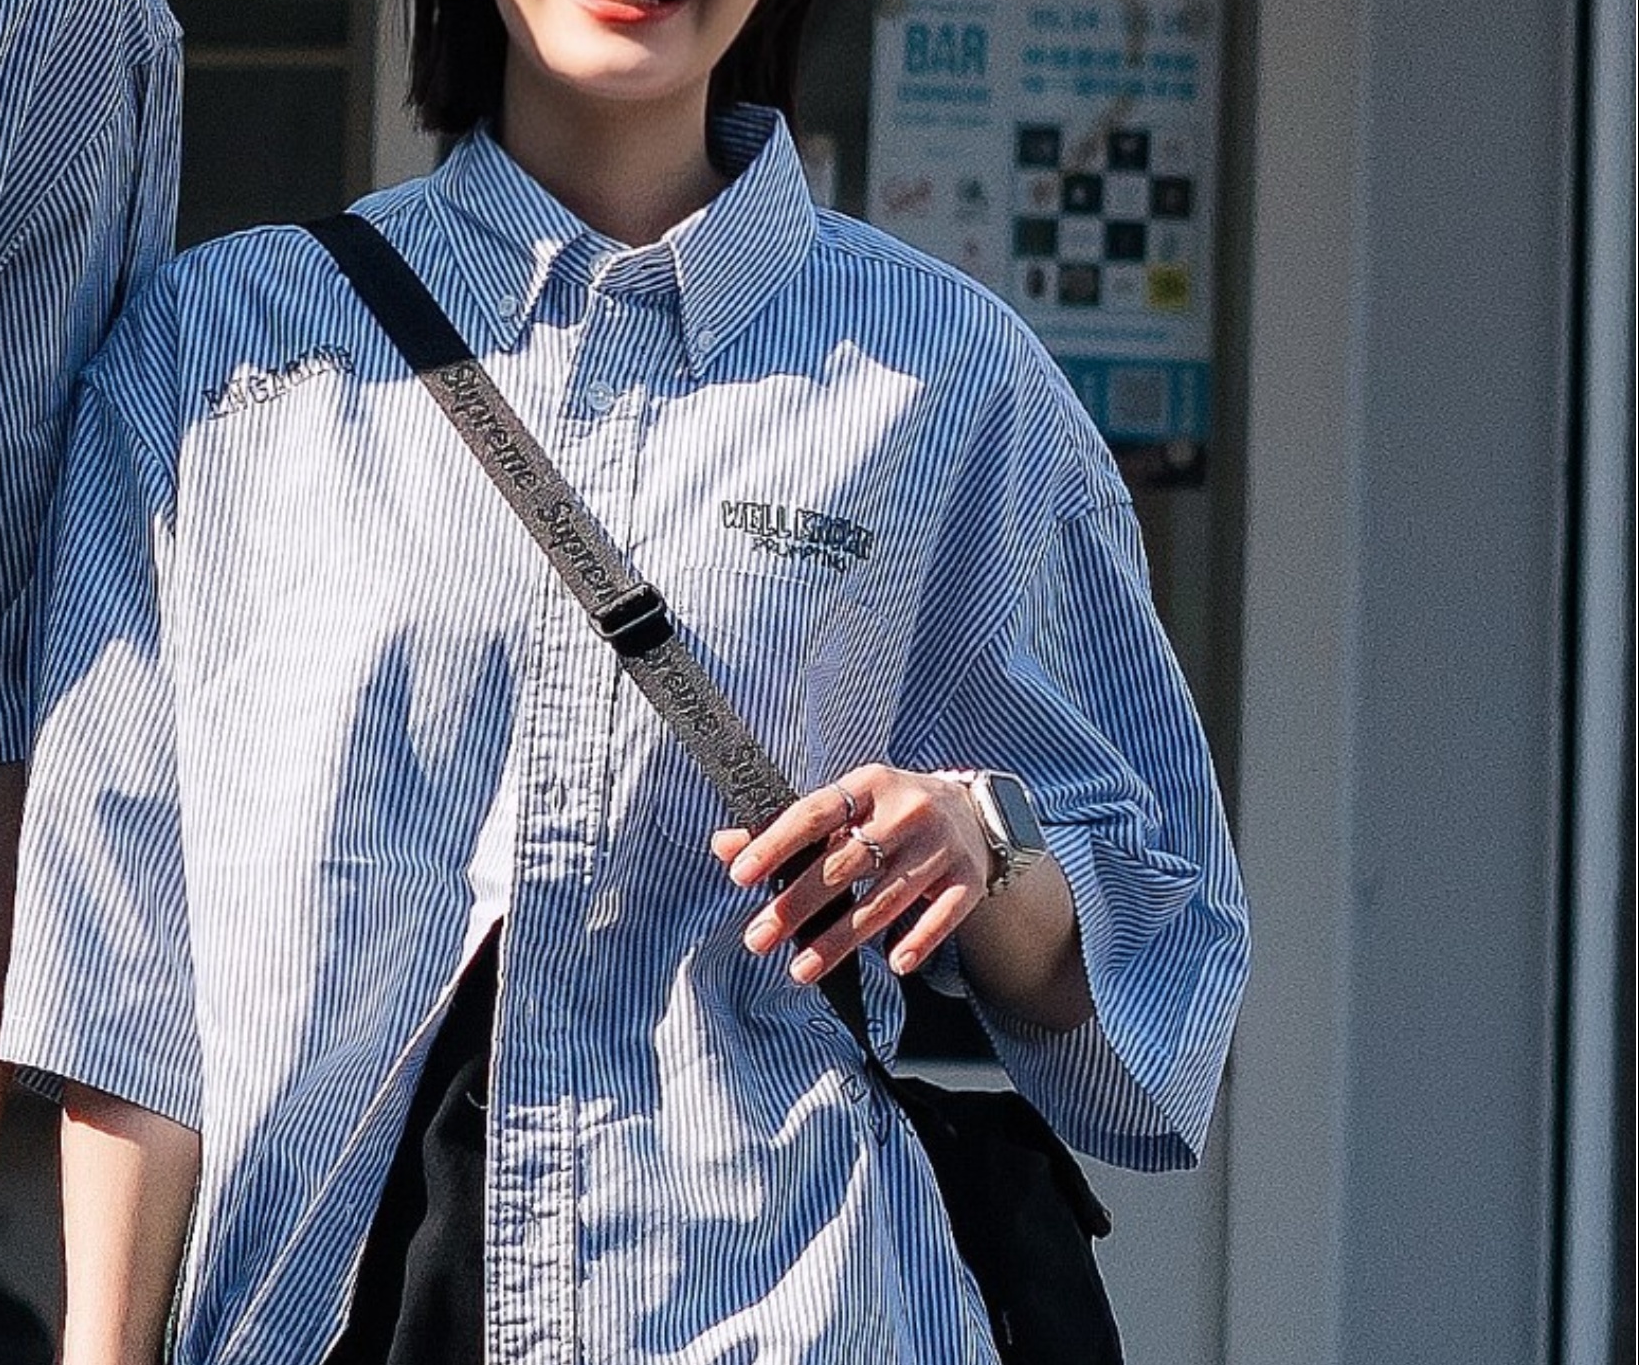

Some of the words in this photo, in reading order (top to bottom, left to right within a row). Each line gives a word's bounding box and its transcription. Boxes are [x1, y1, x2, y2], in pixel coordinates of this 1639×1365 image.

[903, 23, 990, 75] BAR
[442, 363, 538, 493] Supreme
[722, 501, 792, 539] WELL
